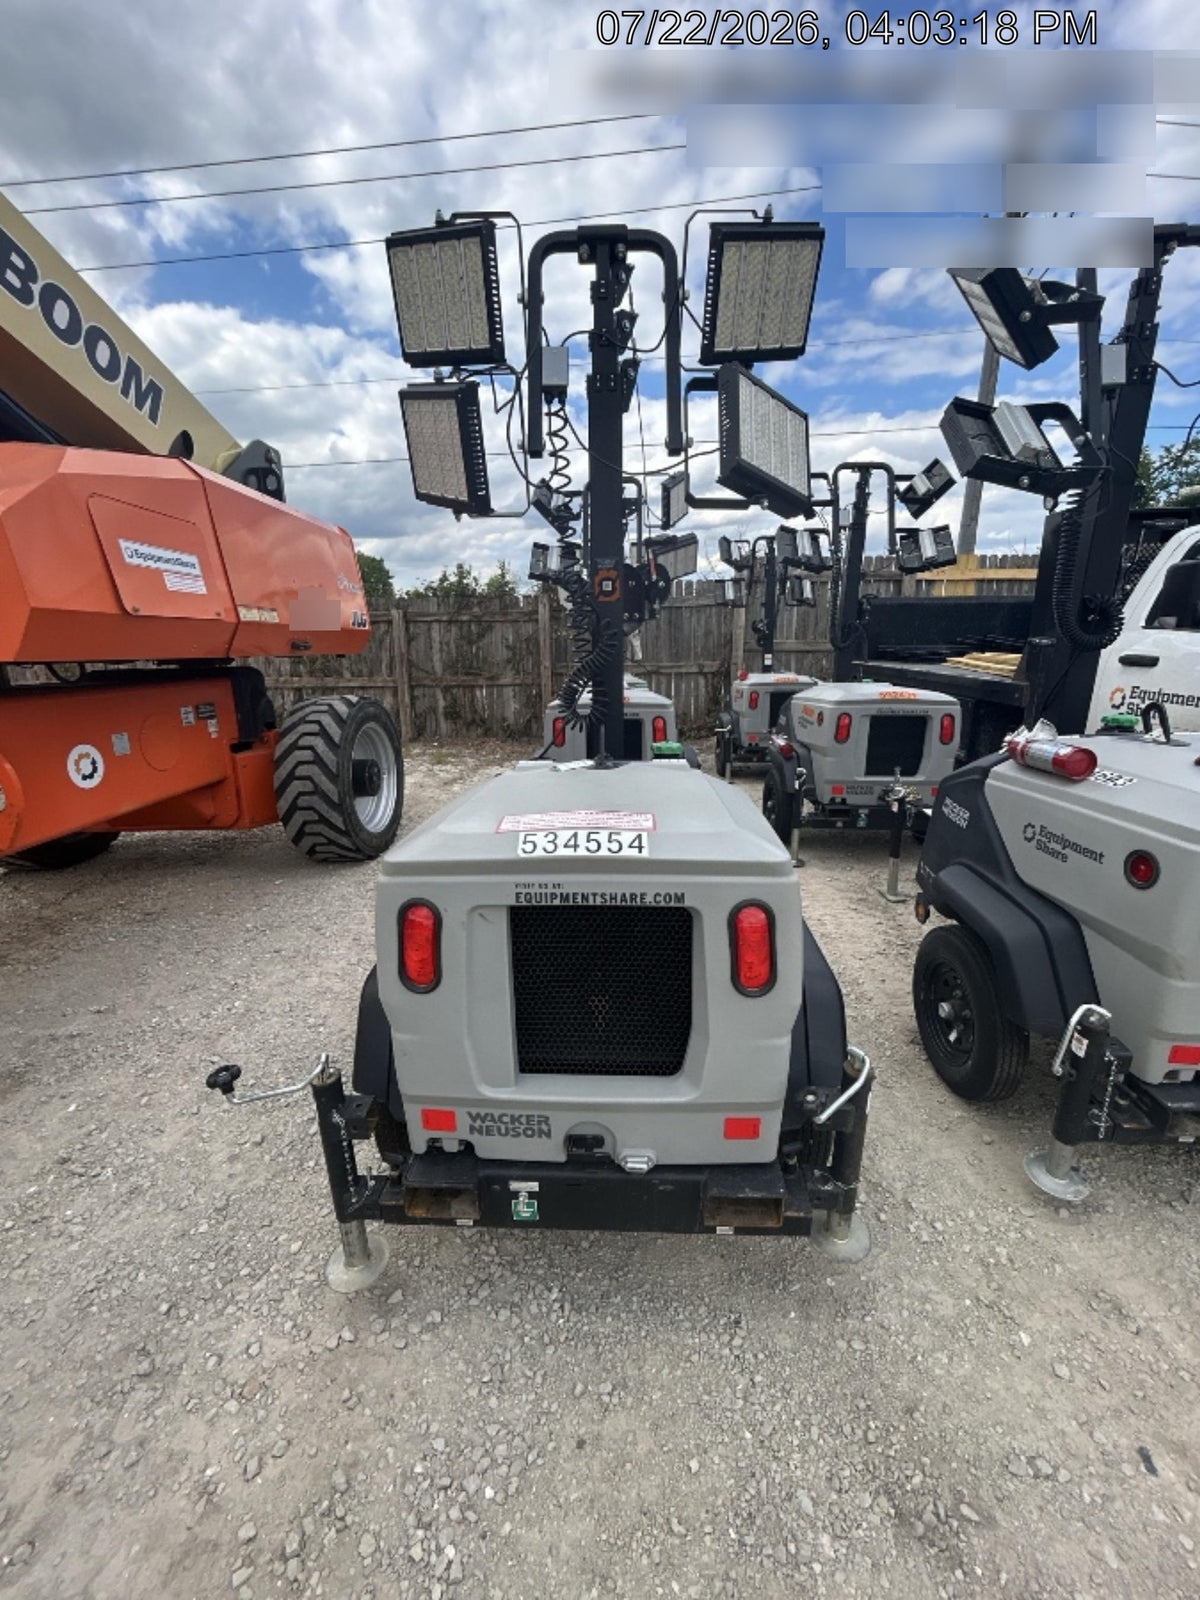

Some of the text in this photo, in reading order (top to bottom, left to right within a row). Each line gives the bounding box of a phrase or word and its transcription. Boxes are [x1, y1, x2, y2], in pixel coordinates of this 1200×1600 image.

[0, 225, 165, 428] BOOM
[520, 831, 646, 854] 534554
[1035, 838, 1068, 863] Share
[1038, 824, 1105, 865] Equipment
[515, 892, 686, 905] EQUIPMENTSHARE.COM
[466, 1111, 551, 1126] WACKER
[469, 1123, 552, 1140] NEUSON
